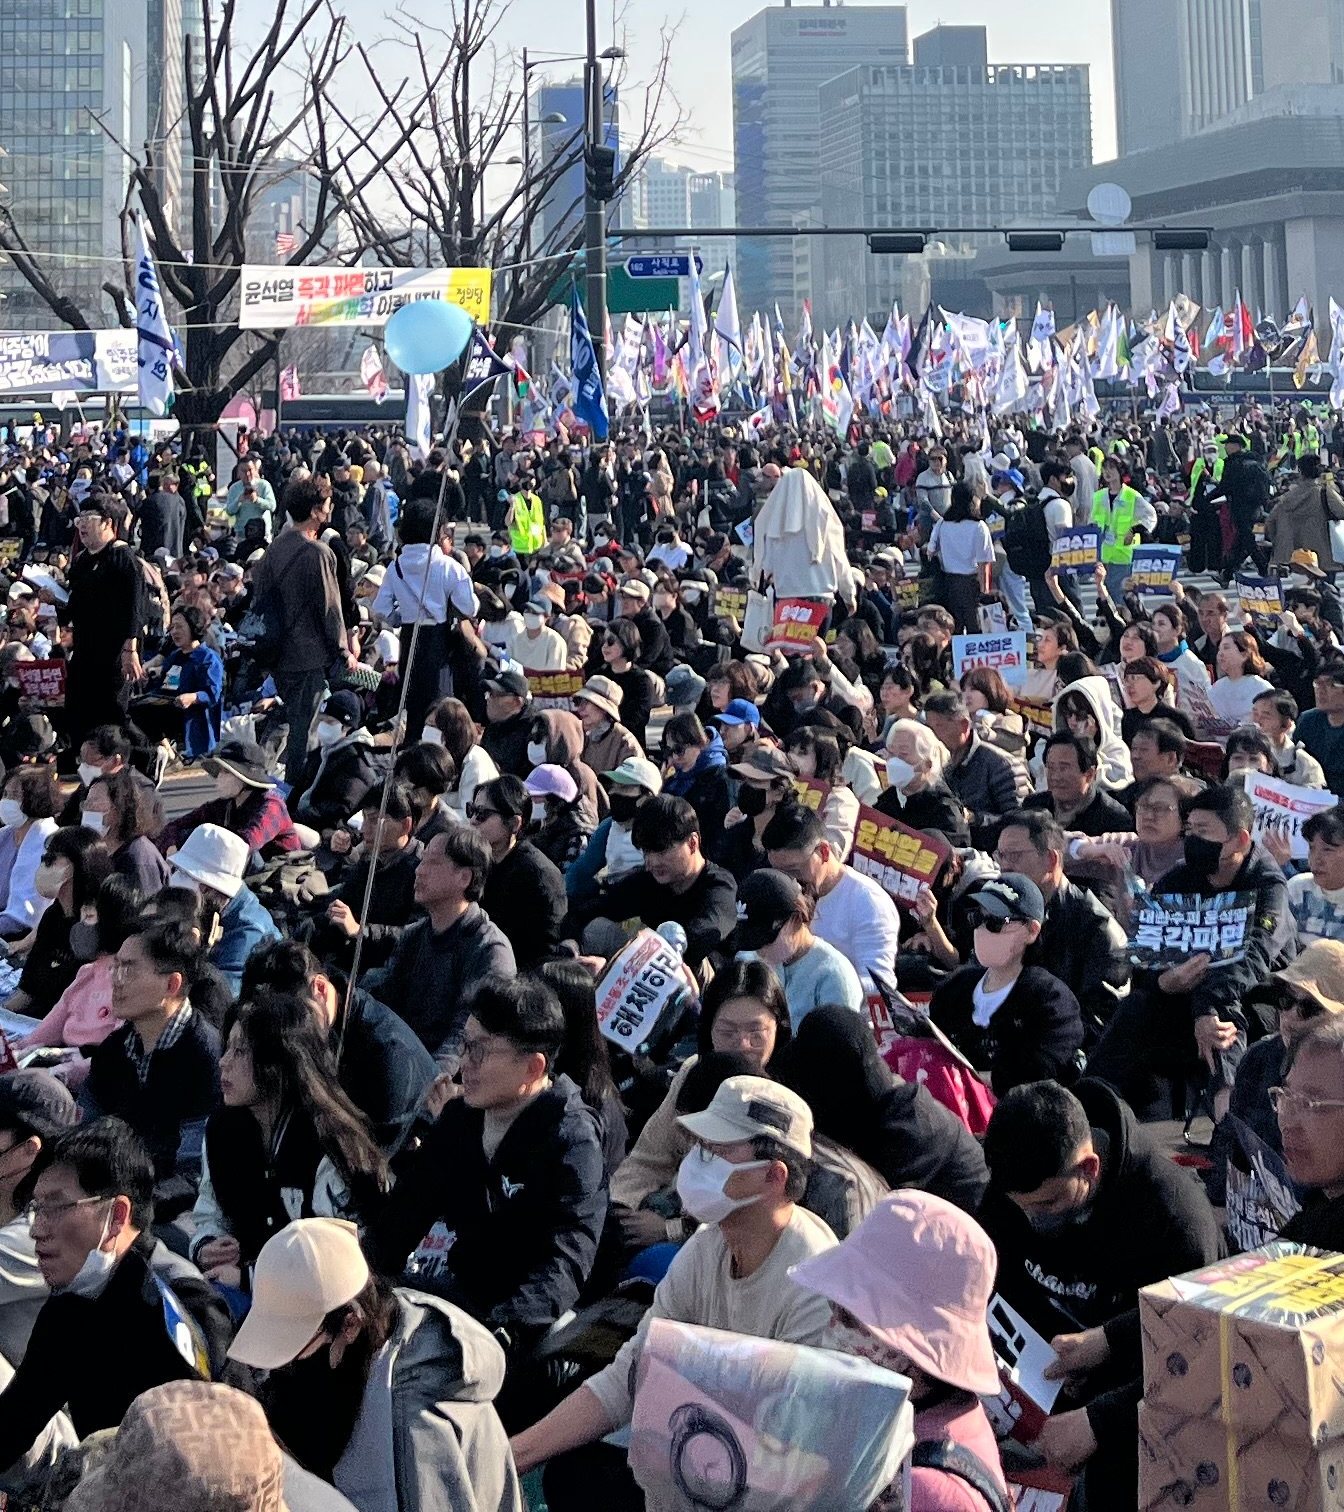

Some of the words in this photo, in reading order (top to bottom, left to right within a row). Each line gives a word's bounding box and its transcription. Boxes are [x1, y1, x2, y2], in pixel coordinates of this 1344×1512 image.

[651, 257, 680, 267] 사직로
[244, 277, 293, 306] 윤석열
[965, 638, 1013, 655] 윤석열은
[1204, 906, 1248, 924] 윤석열
[1135, 922, 1246, 954] 즉각파면
